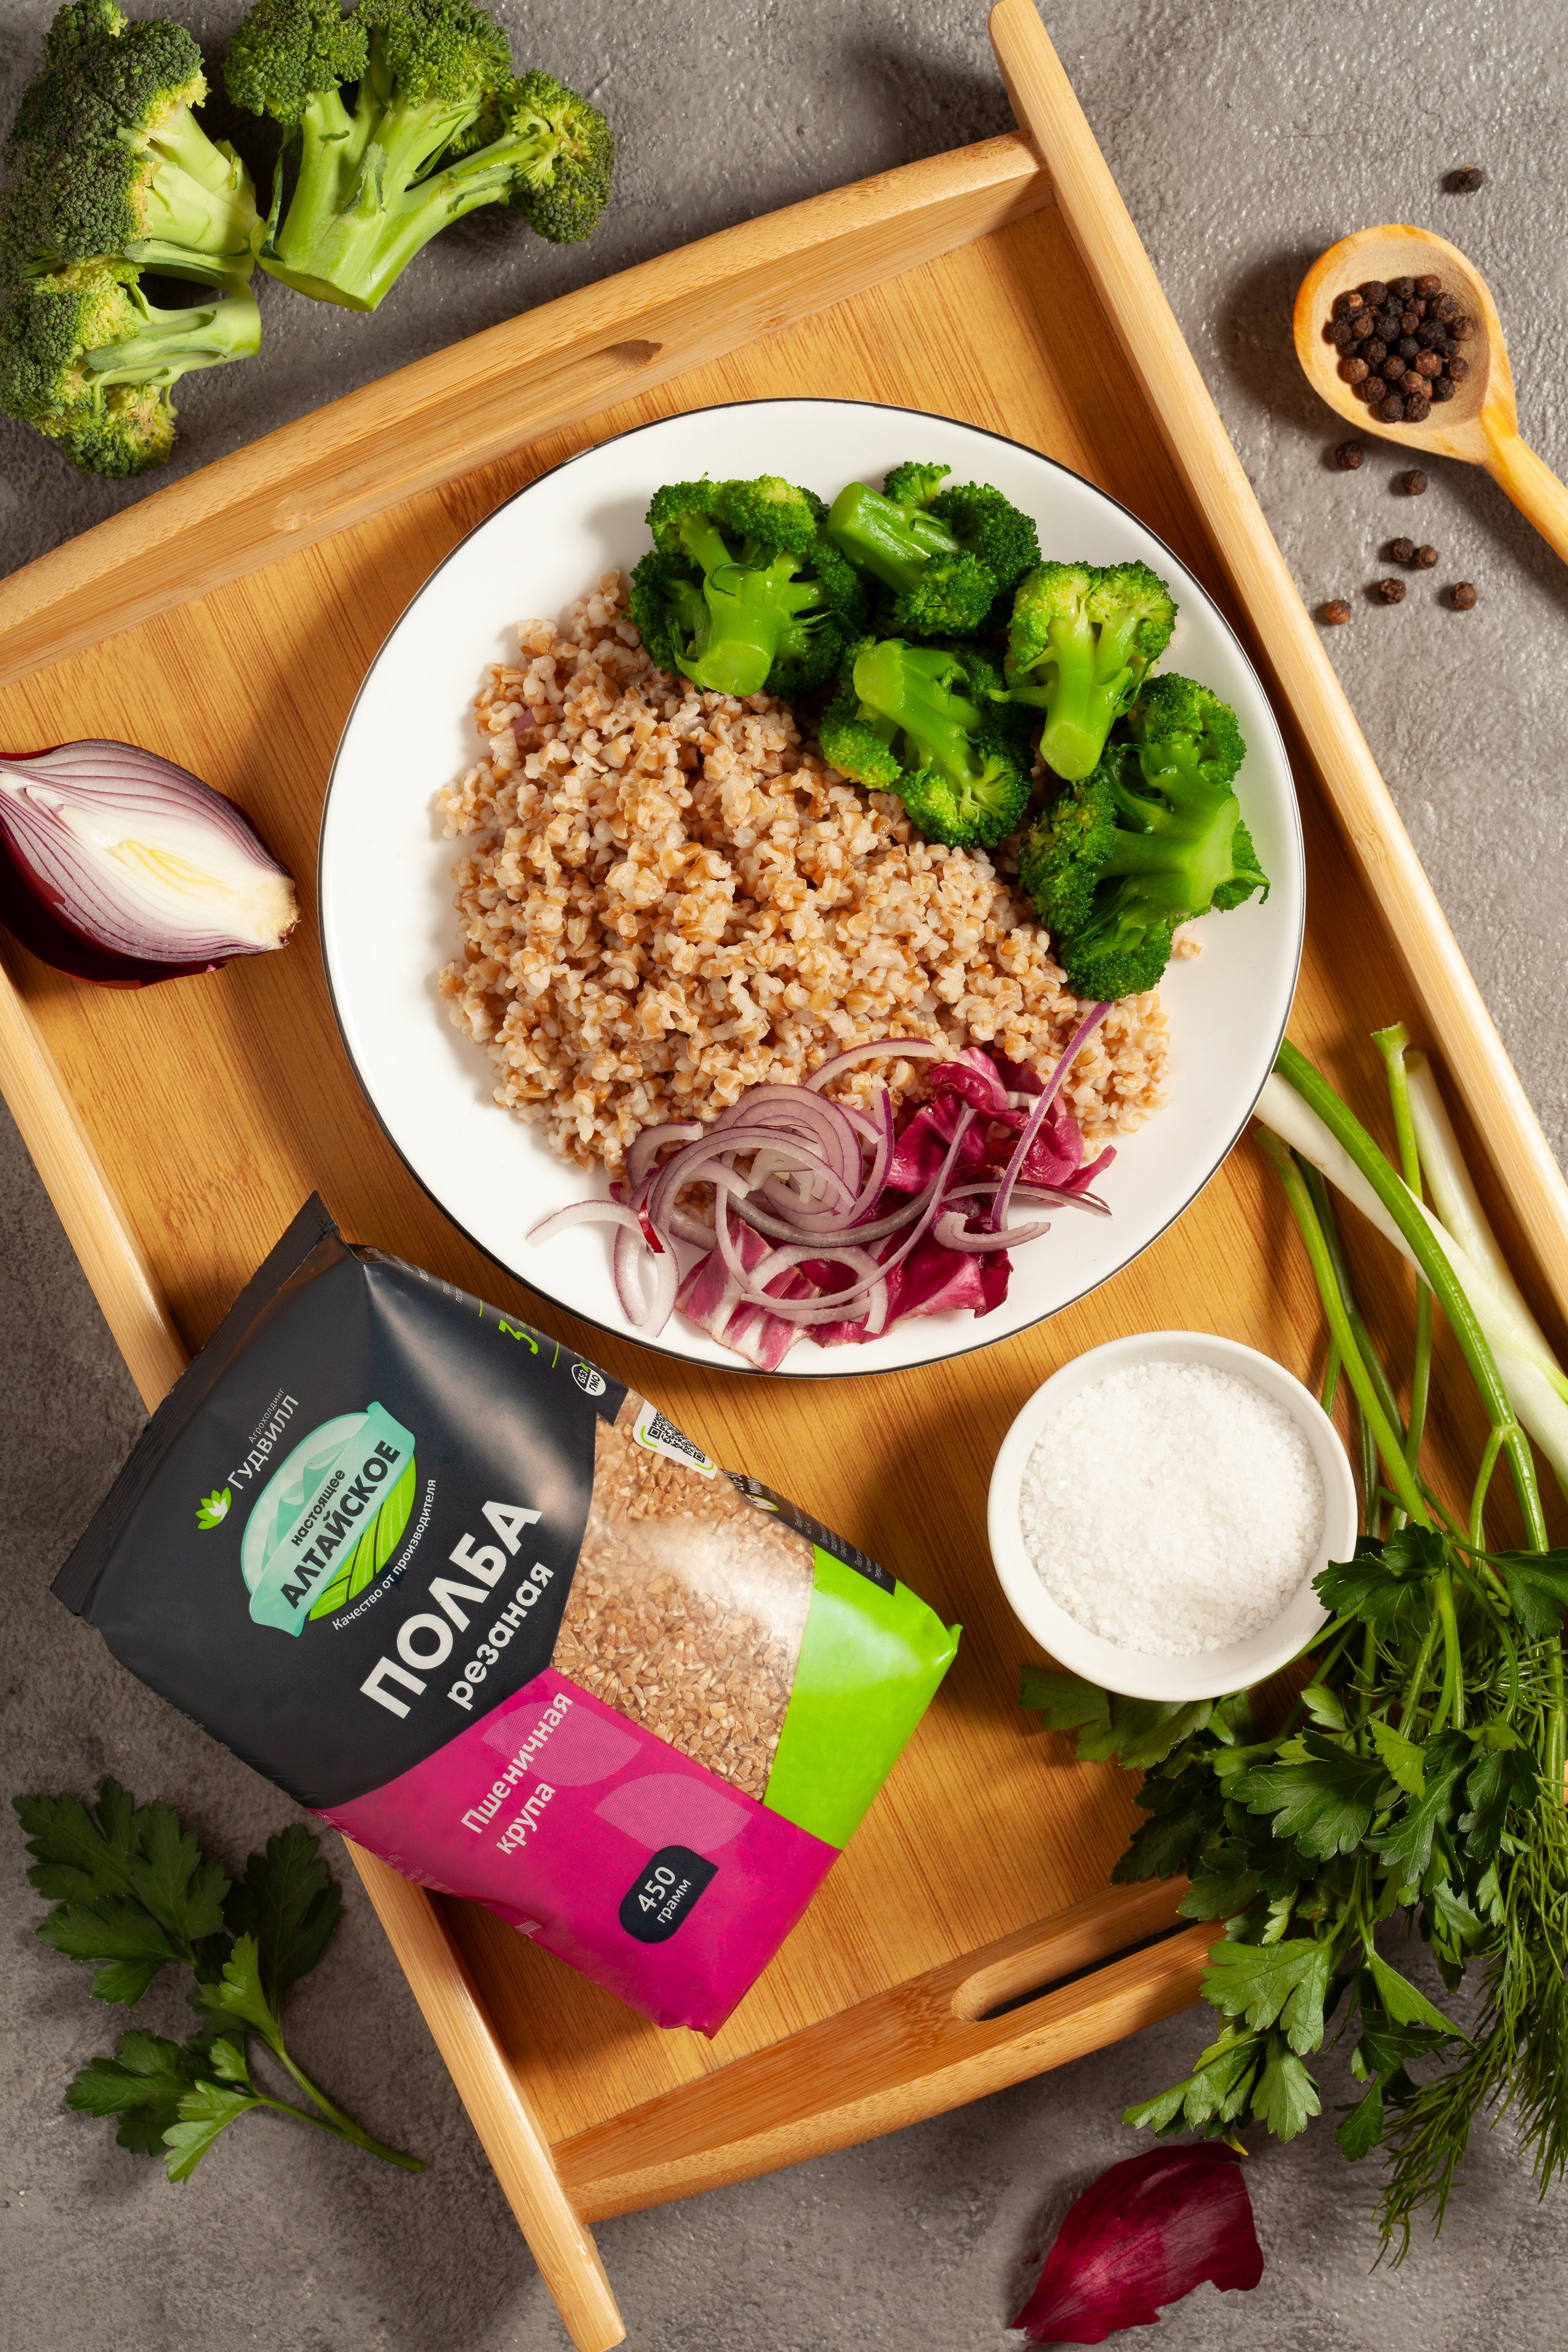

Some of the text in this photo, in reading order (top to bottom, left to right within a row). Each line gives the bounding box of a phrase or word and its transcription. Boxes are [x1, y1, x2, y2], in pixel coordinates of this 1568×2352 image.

[499, 1319, 539, 1355] 3
[578, 1369, 588, 1384] БЕЗ
[589, 1374, 600, 1392] ГМО
[227, 1395, 299, 1490] ГУДВИЛЛ
[248, 1387, 285, 1444] Агрохолдинг
[280, 1440, 401, 1610] АЛТАЙСКОЕ
[291, 1469, 345, 1546] настоящее
[332, 1479, 437, 1630] Качество от производителя
[360, 1501, 543, 1719] ПОЛБА
[447, 1562, 554, 1711] резаная
[461, 1692, 573, 1833] Пшеничная
[496, 1782, 556, 1855] крупа
[638, 1866, 676, 1913] 450
[657, 1879, 692, 1924] грамм
